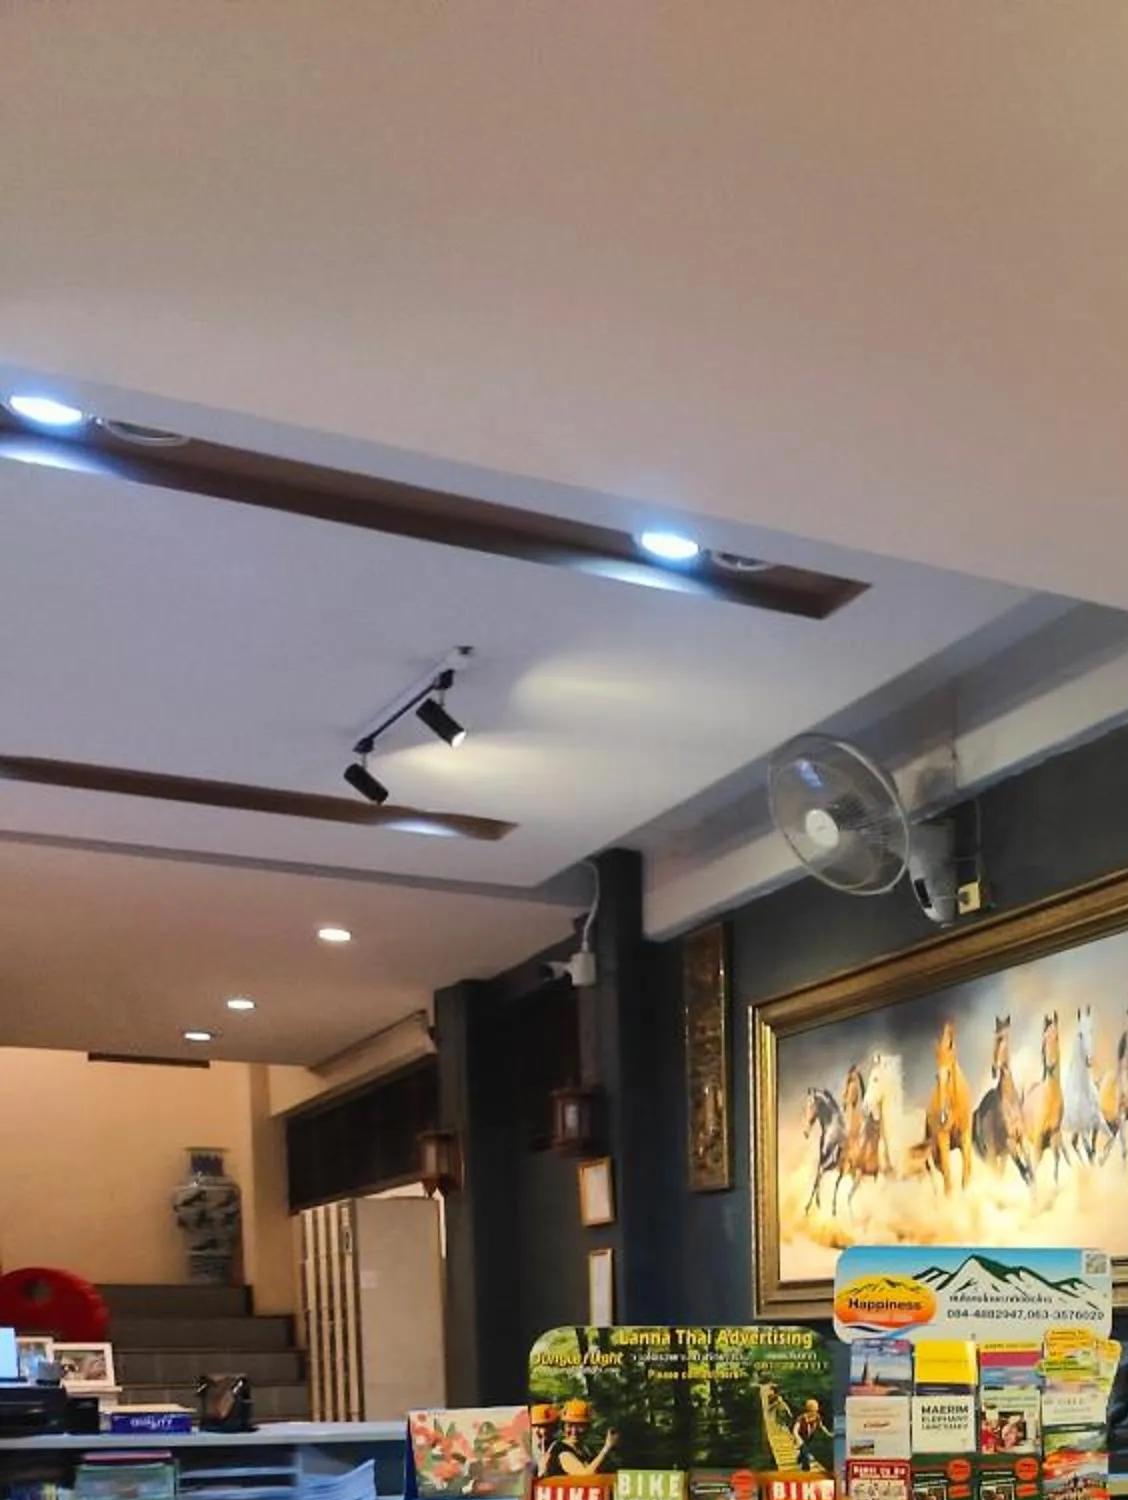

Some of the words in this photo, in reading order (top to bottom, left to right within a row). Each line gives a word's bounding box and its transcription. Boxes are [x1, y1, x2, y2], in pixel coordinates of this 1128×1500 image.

[848, 1298, 922, 1312] Happiness
[620, 1330, 671, 1346] Lanna
[676, 1329, 711, 1346] Thai
[716, 1329, 813, 1349] Advertising
[617, 1473, 681, 1498] BIKE
[773, 1480, 834, 1500] BIKE
